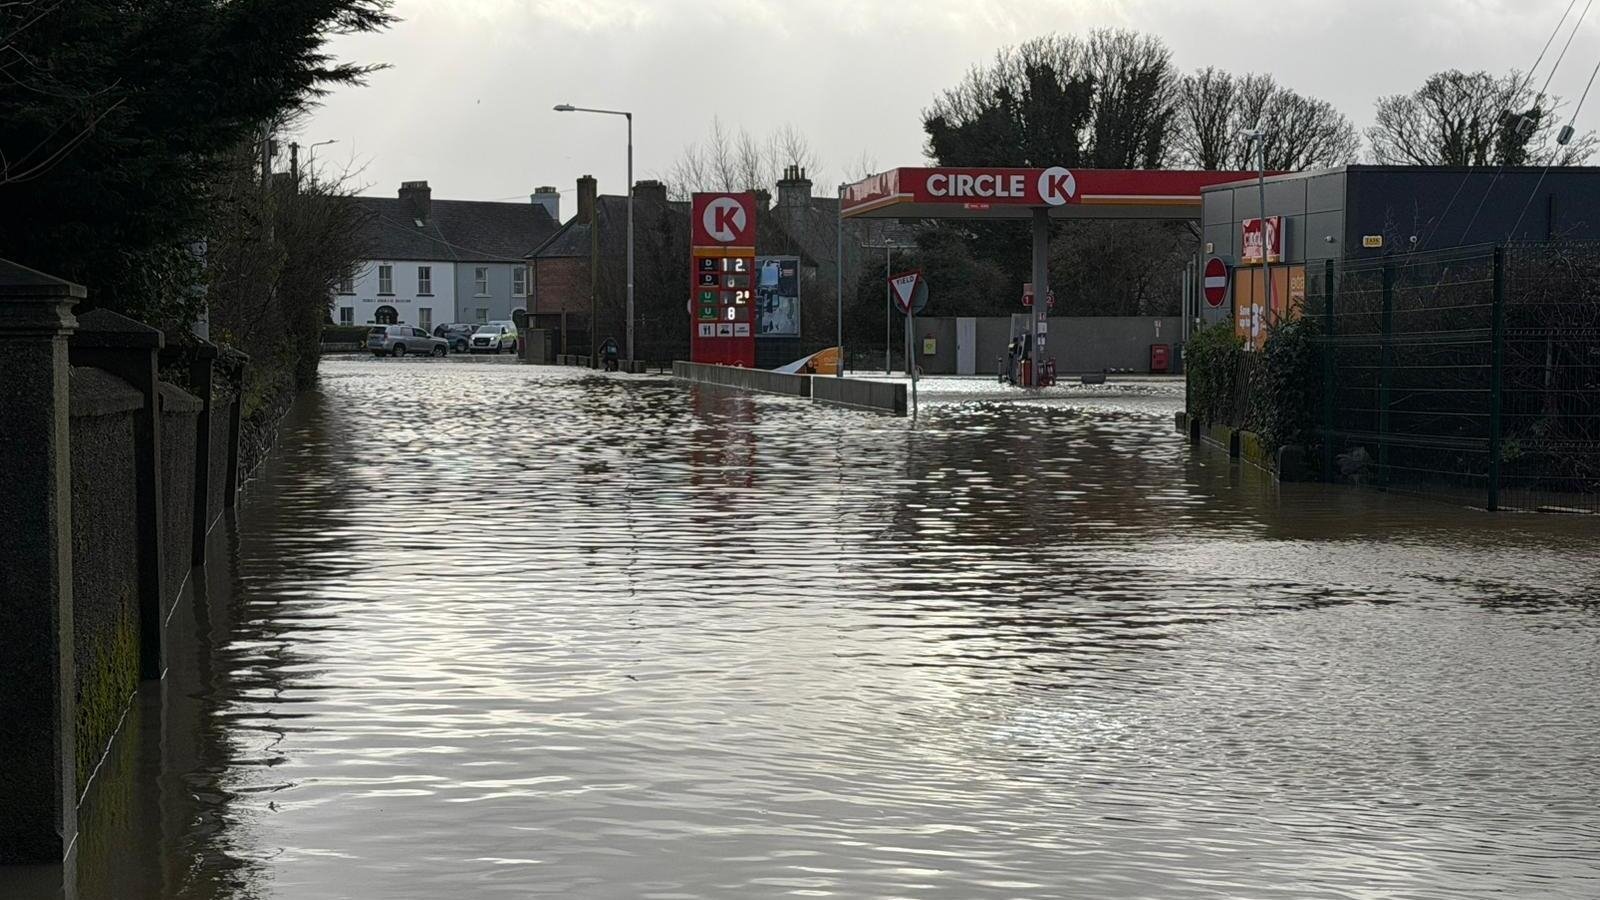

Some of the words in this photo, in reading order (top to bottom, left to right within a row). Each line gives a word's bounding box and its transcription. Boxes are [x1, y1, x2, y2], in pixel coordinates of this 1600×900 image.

[926, 173, 1025, 197] CIRCLE
[705, 259, 713, 267] D
[896, 276, 914, 285] YIELD
